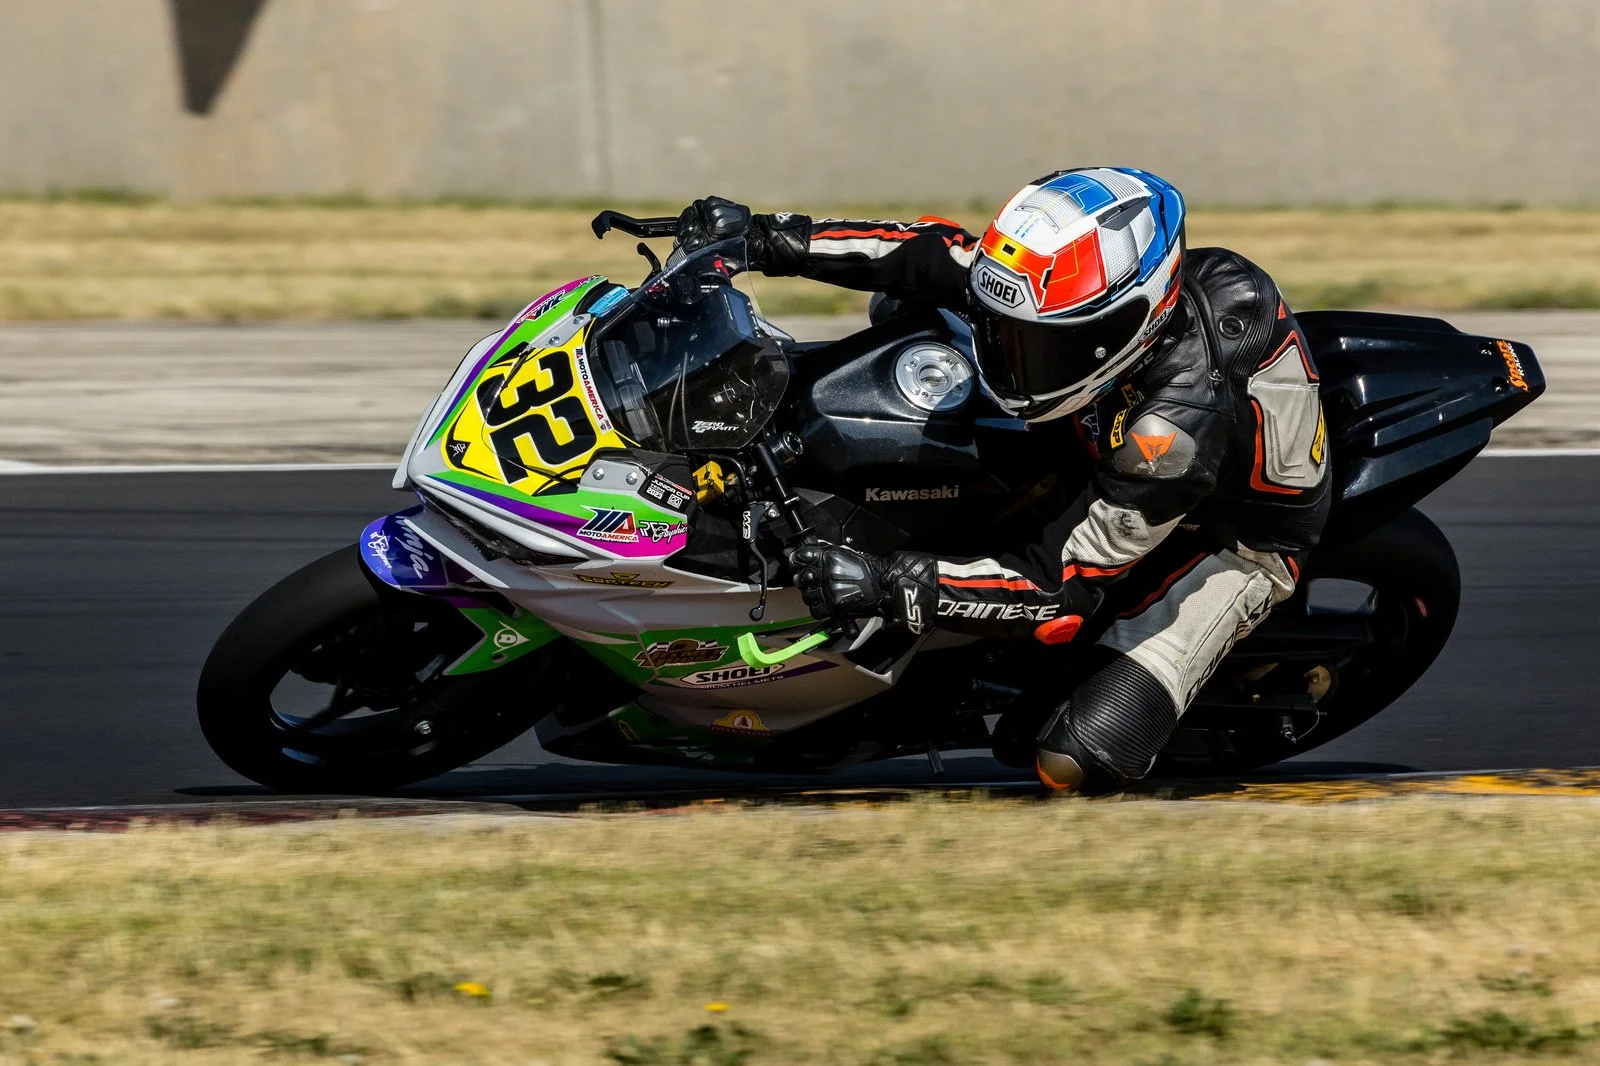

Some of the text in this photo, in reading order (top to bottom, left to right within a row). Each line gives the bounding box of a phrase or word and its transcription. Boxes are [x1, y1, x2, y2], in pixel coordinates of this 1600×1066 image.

[980, 271, 1018, 304] SHOEI
[1143, 311, 1167, 336] SHOEI
[578, 358, 604, 421] MOTOAMERICA
[476, 350, 597, 485] 32
[651, 479, 676, 494] JUNIOR
[675, 490, 691, 500] CUP
[865, 485, 959, 502] Kawasaki
[579, 530, 638, 542] MOTOAMERICA
[937, 599, 1061, 621] DAINESE
[696, 667, 771, 683] SHOEI
